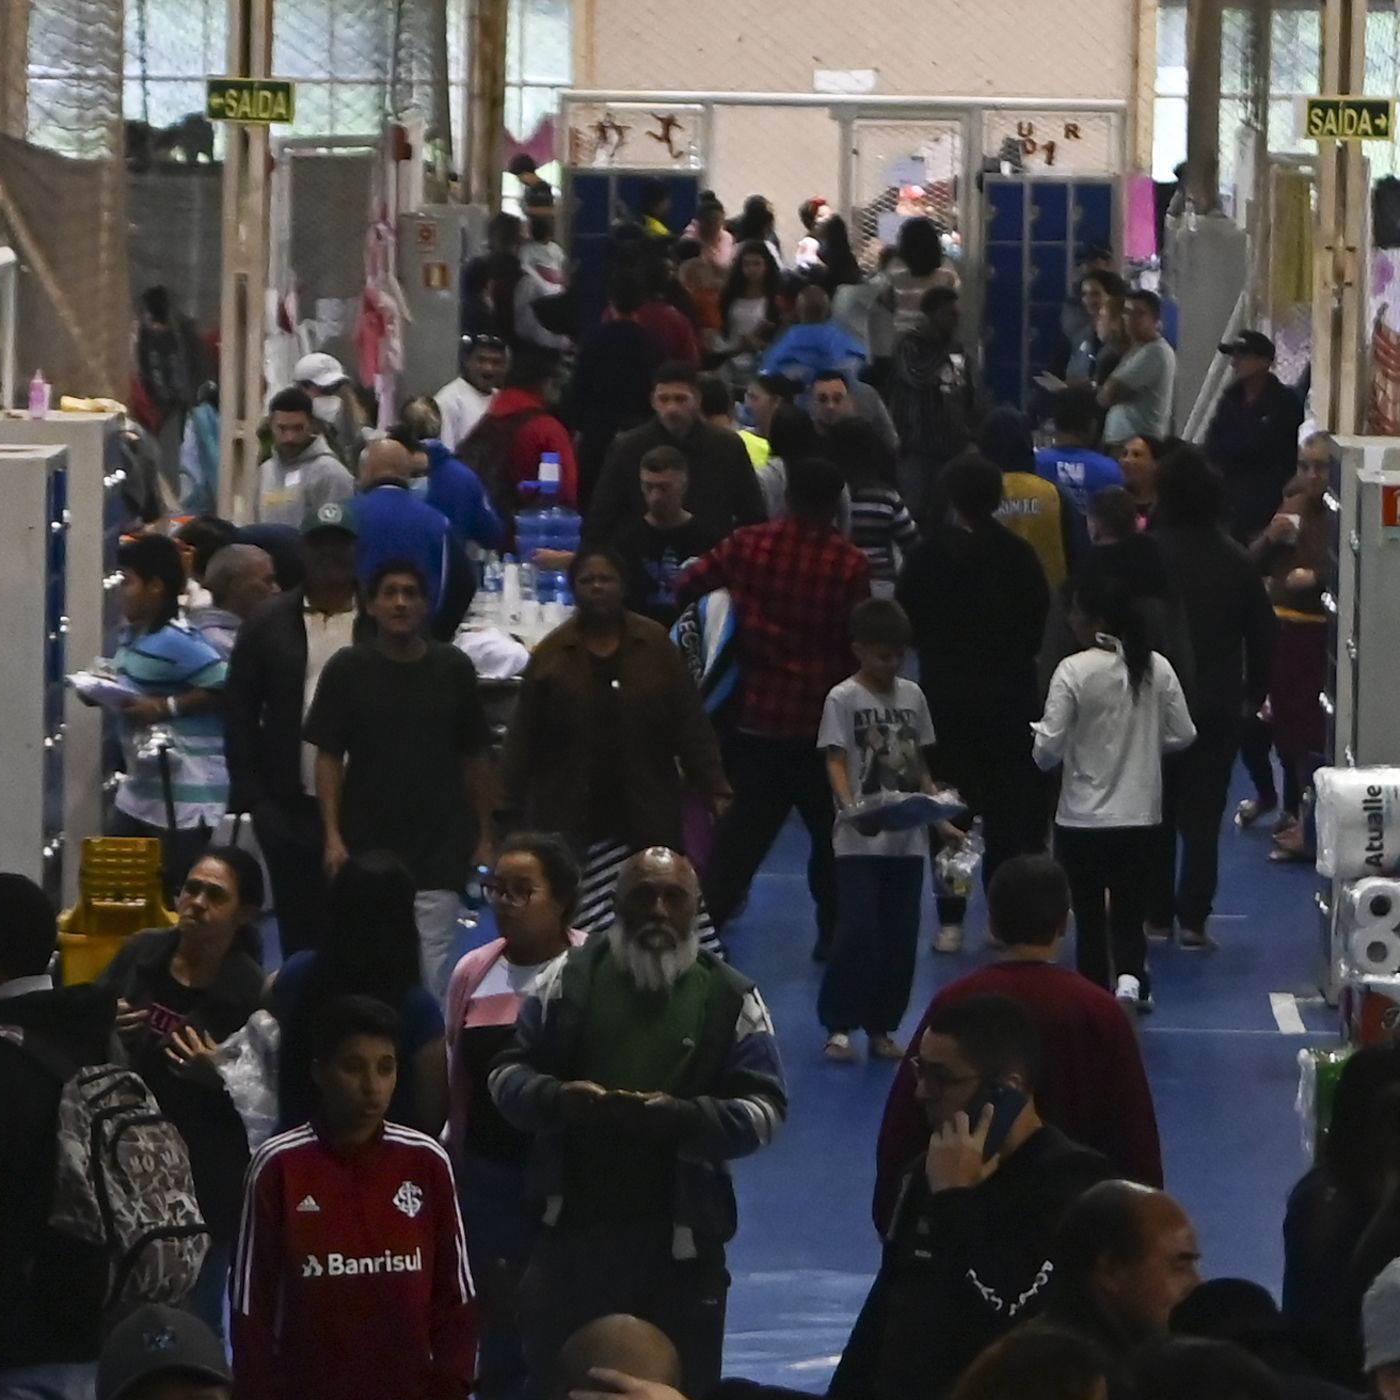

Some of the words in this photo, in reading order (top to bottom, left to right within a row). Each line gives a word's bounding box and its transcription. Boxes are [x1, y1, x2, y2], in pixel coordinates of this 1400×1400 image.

[1310, 101, 1374, 135] SAÍDA
[1363, 784, 1385, 868] Atualle
[327, 1246, 423, 1276] Banrisul
